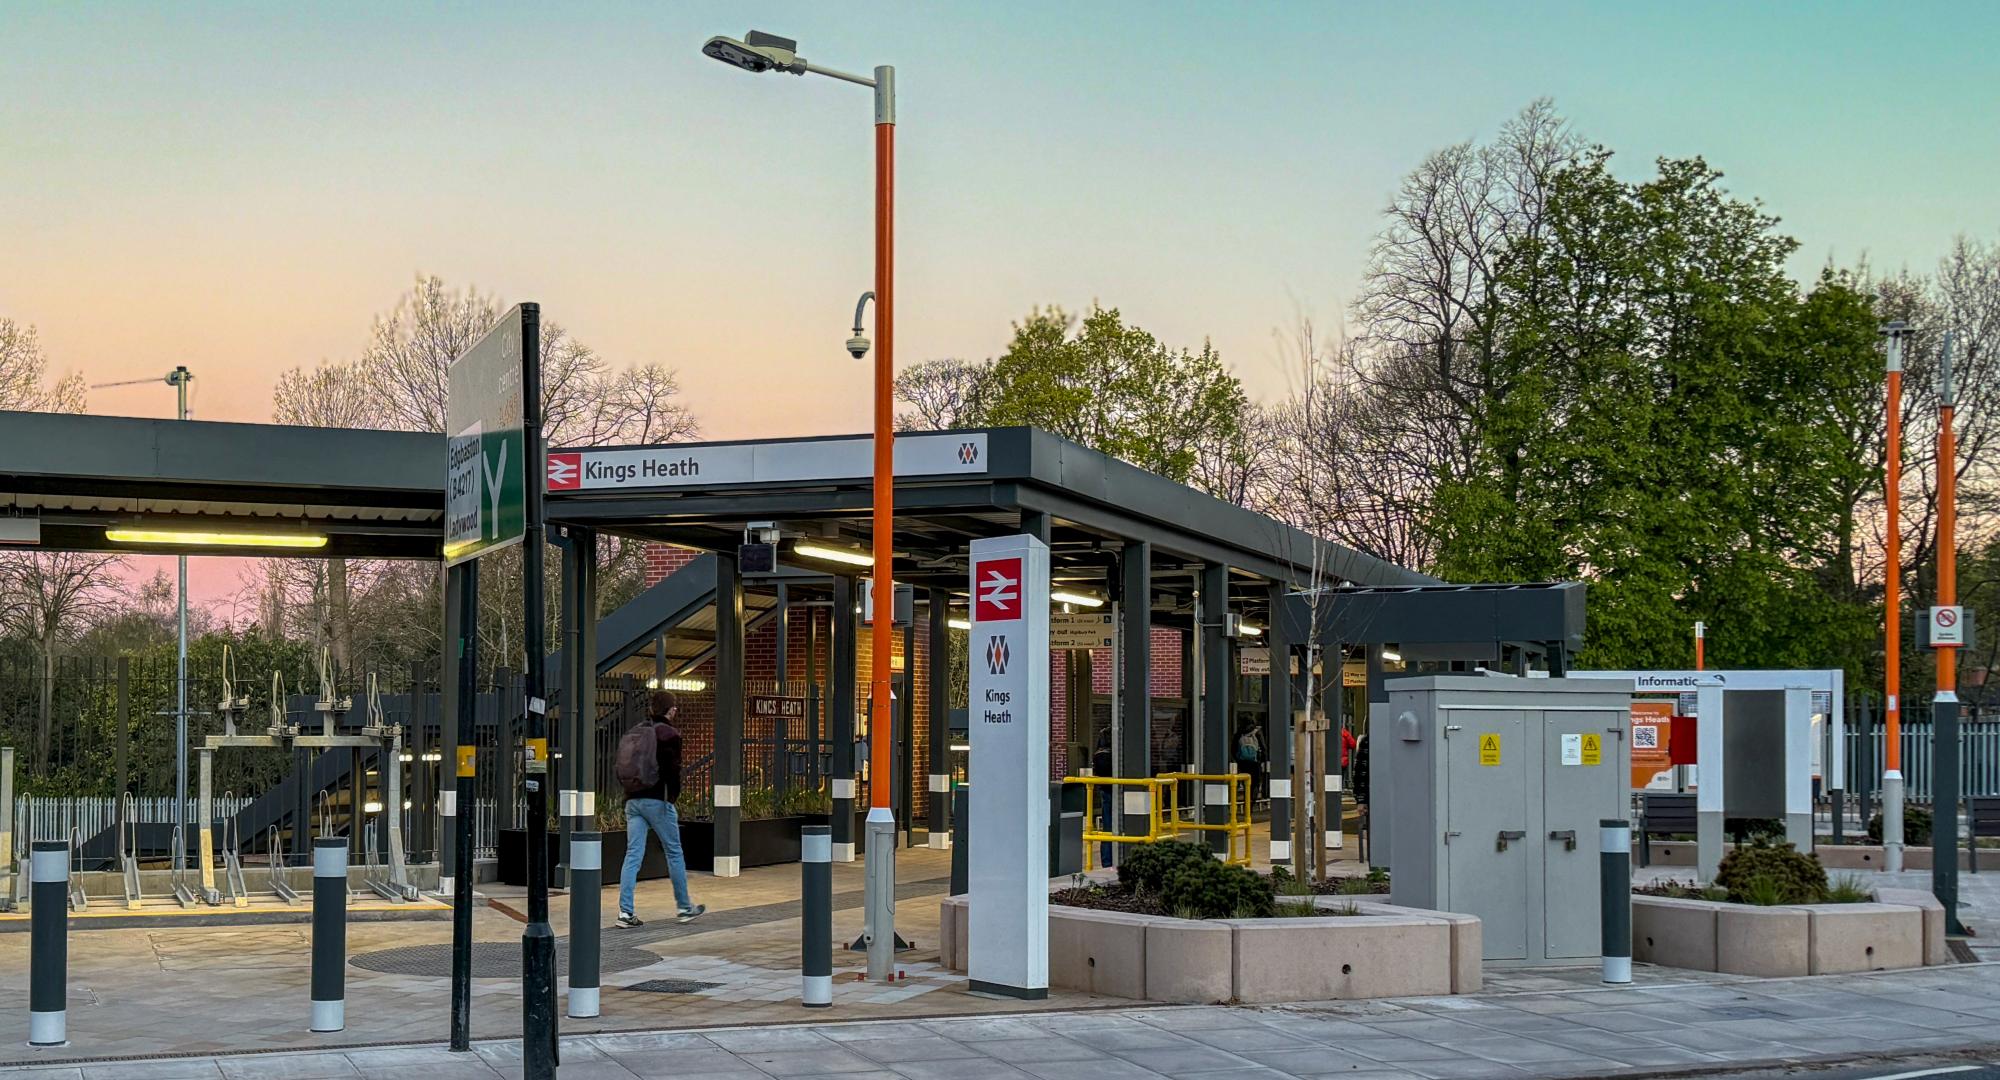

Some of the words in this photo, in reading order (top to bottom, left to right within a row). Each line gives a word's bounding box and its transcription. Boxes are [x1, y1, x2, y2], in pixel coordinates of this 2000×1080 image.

[450, 438, 480, 470] Edgbaston
[585, 461, 636, 482] Kings
[642, 457, 699, 477] Heath
[449, 466, 475, 504] (B4217)
[449, 505, 478, 539] Ladywood
[1638, 676, 1698, 686] Informatio
[985, 689, 1010, 705] Kings
[756, 700, 777, 715] KINGS
[781, 700, 802, 715] HEATH
[984, 710, 1011, 723] Heath
